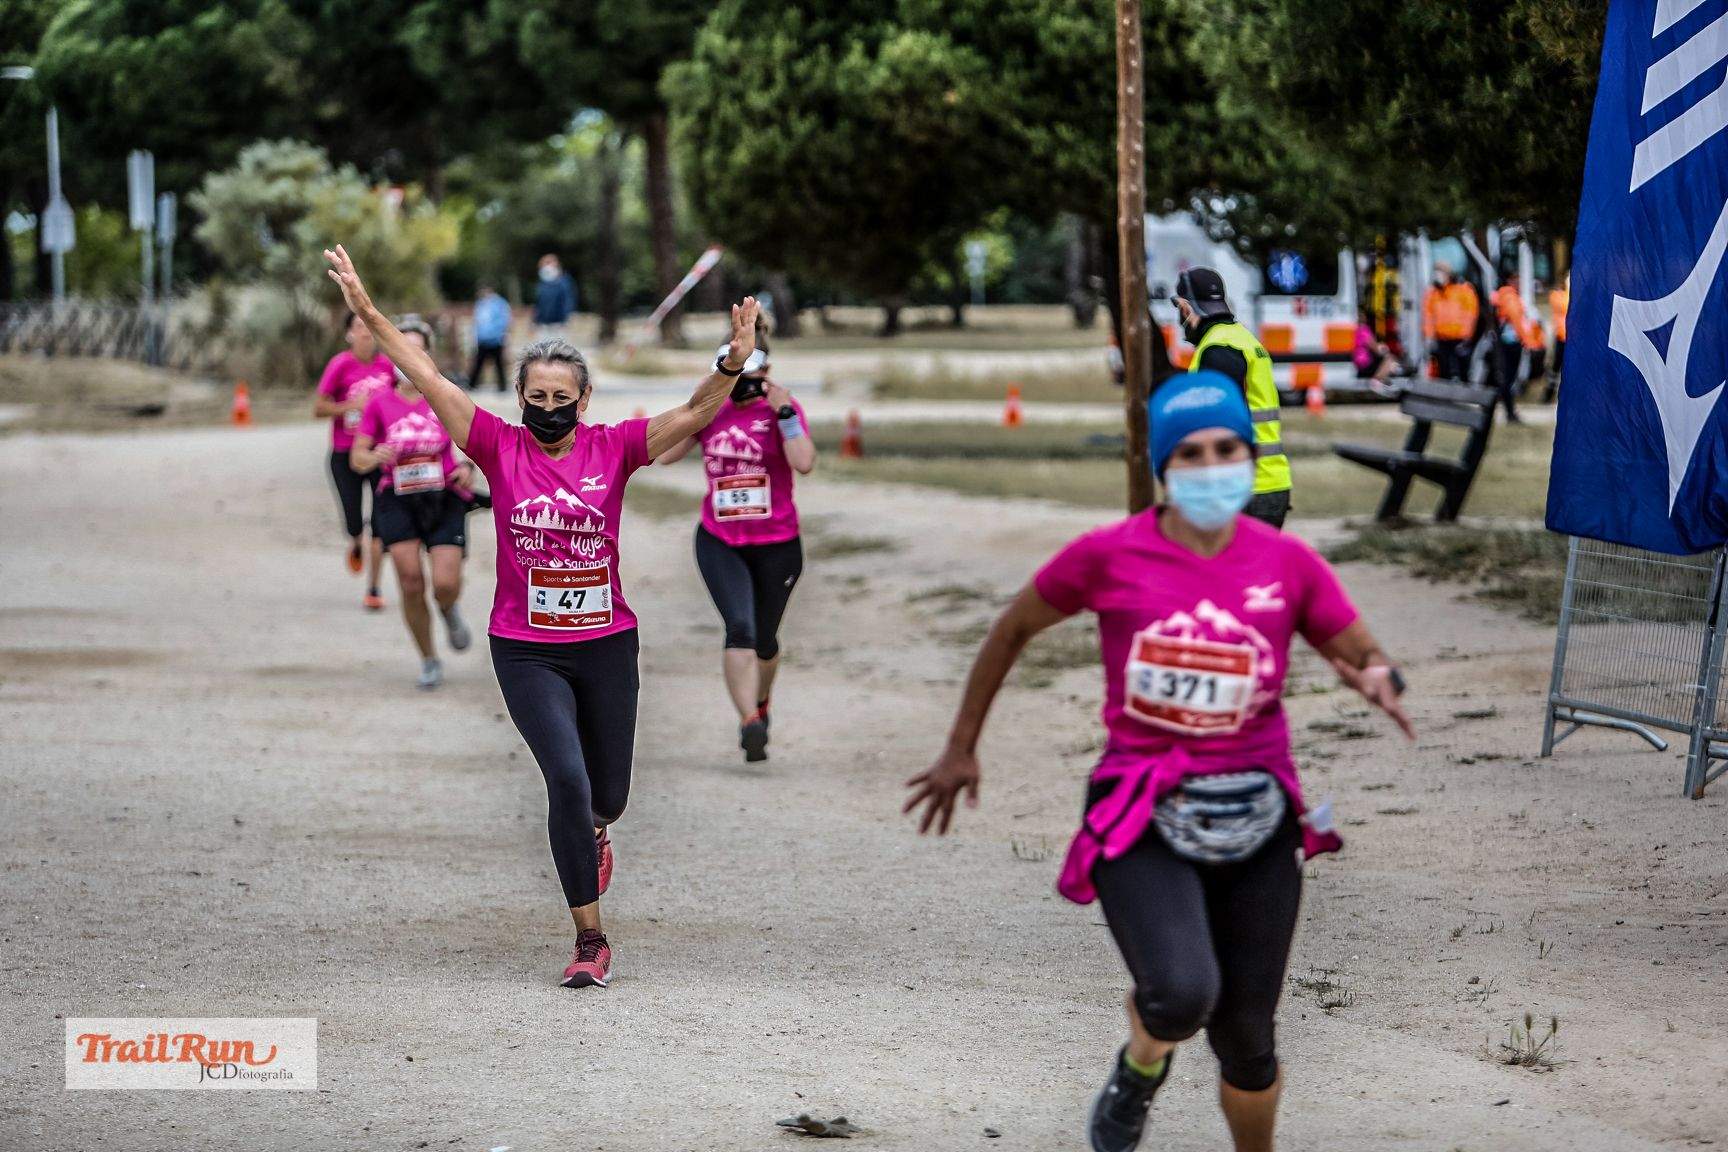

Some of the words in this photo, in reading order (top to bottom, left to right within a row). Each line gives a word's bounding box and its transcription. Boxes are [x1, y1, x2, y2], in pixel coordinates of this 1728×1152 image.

[509, 527, 546, 551] Trail
[570, 533, 614, 559] Mujer
[516, 551, 548, 567] Sports
[564, 554, 612, 569] Santander
[543, 575, 562, 583] Sports
[571, 574, 601, 583] Santander
[557, 589, 587, 610] 47
[1159, 672, 1217, 705] 371
